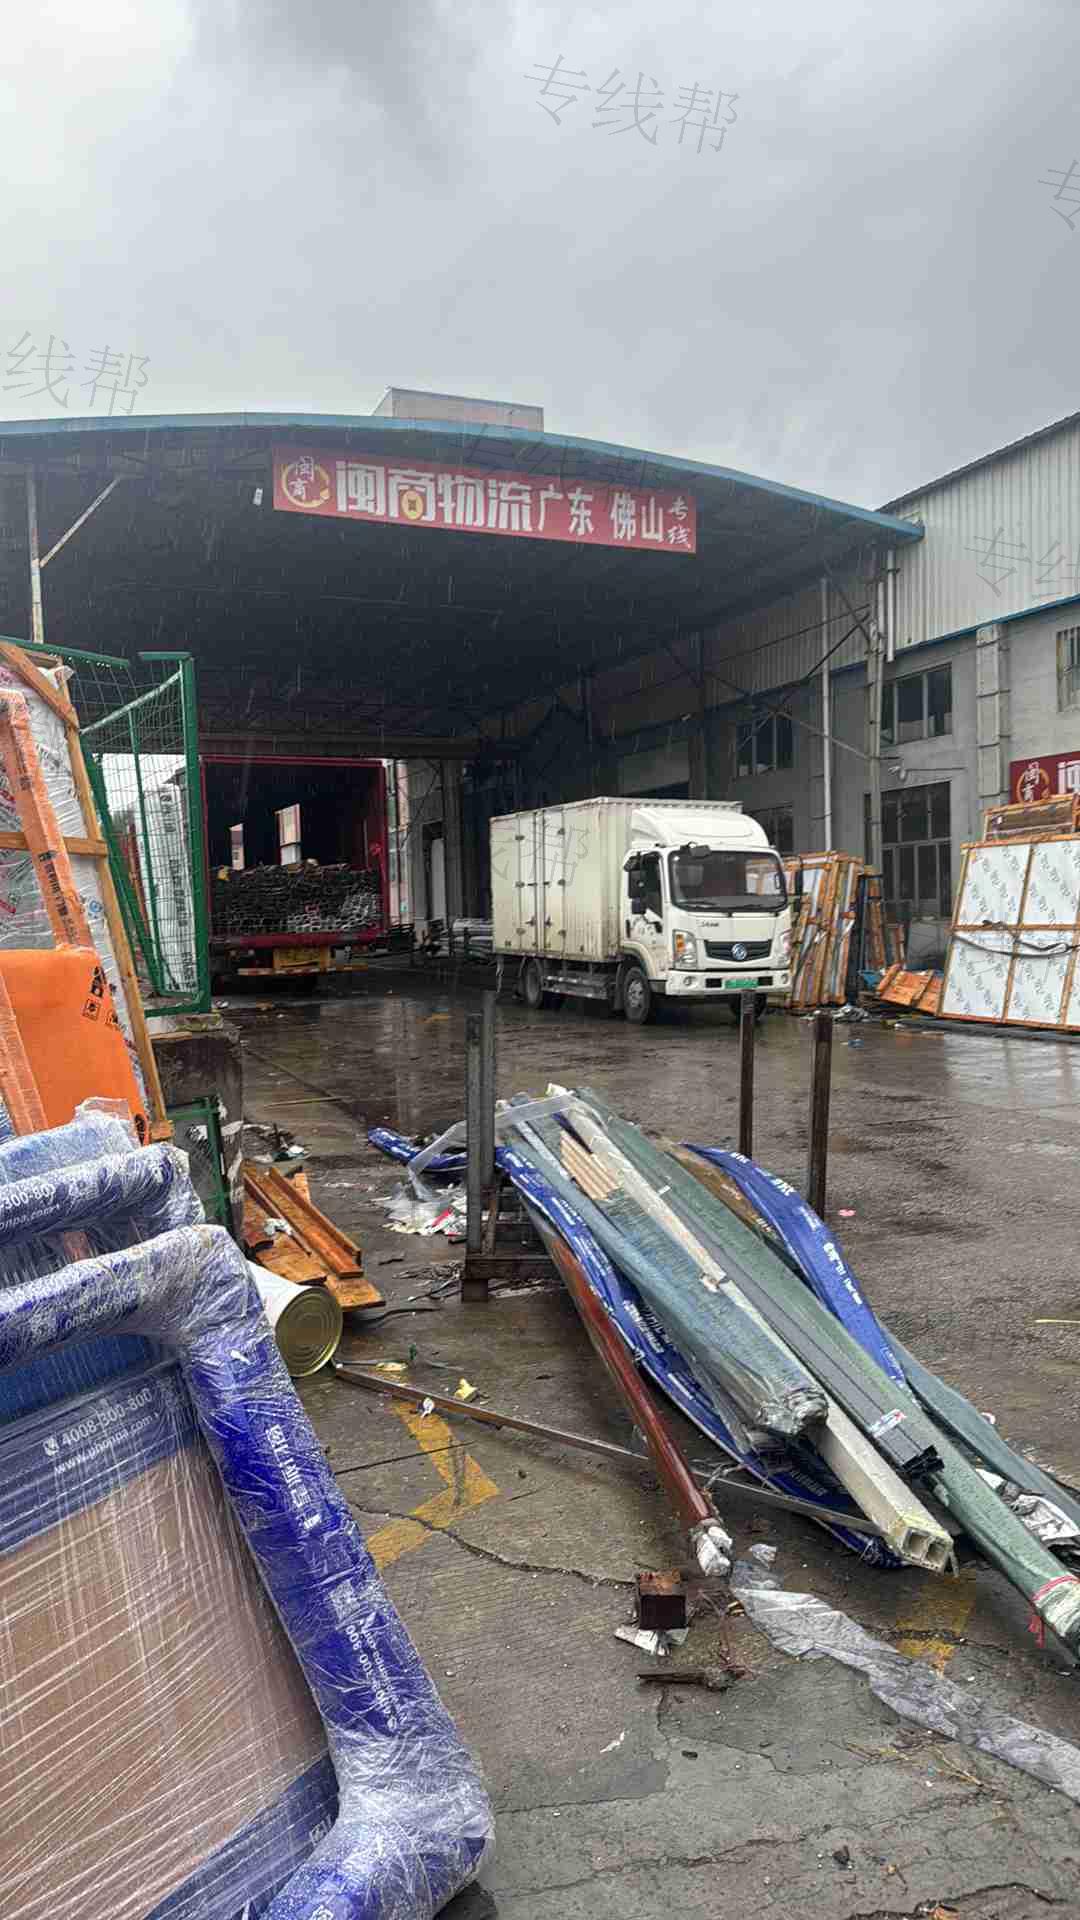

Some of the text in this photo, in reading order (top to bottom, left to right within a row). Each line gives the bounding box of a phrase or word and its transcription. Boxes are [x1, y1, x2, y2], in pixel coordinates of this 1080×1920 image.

[336, 460, 665, 543] 闽商物流 广东 佛山
[667, 495, 691, 548] 专线
